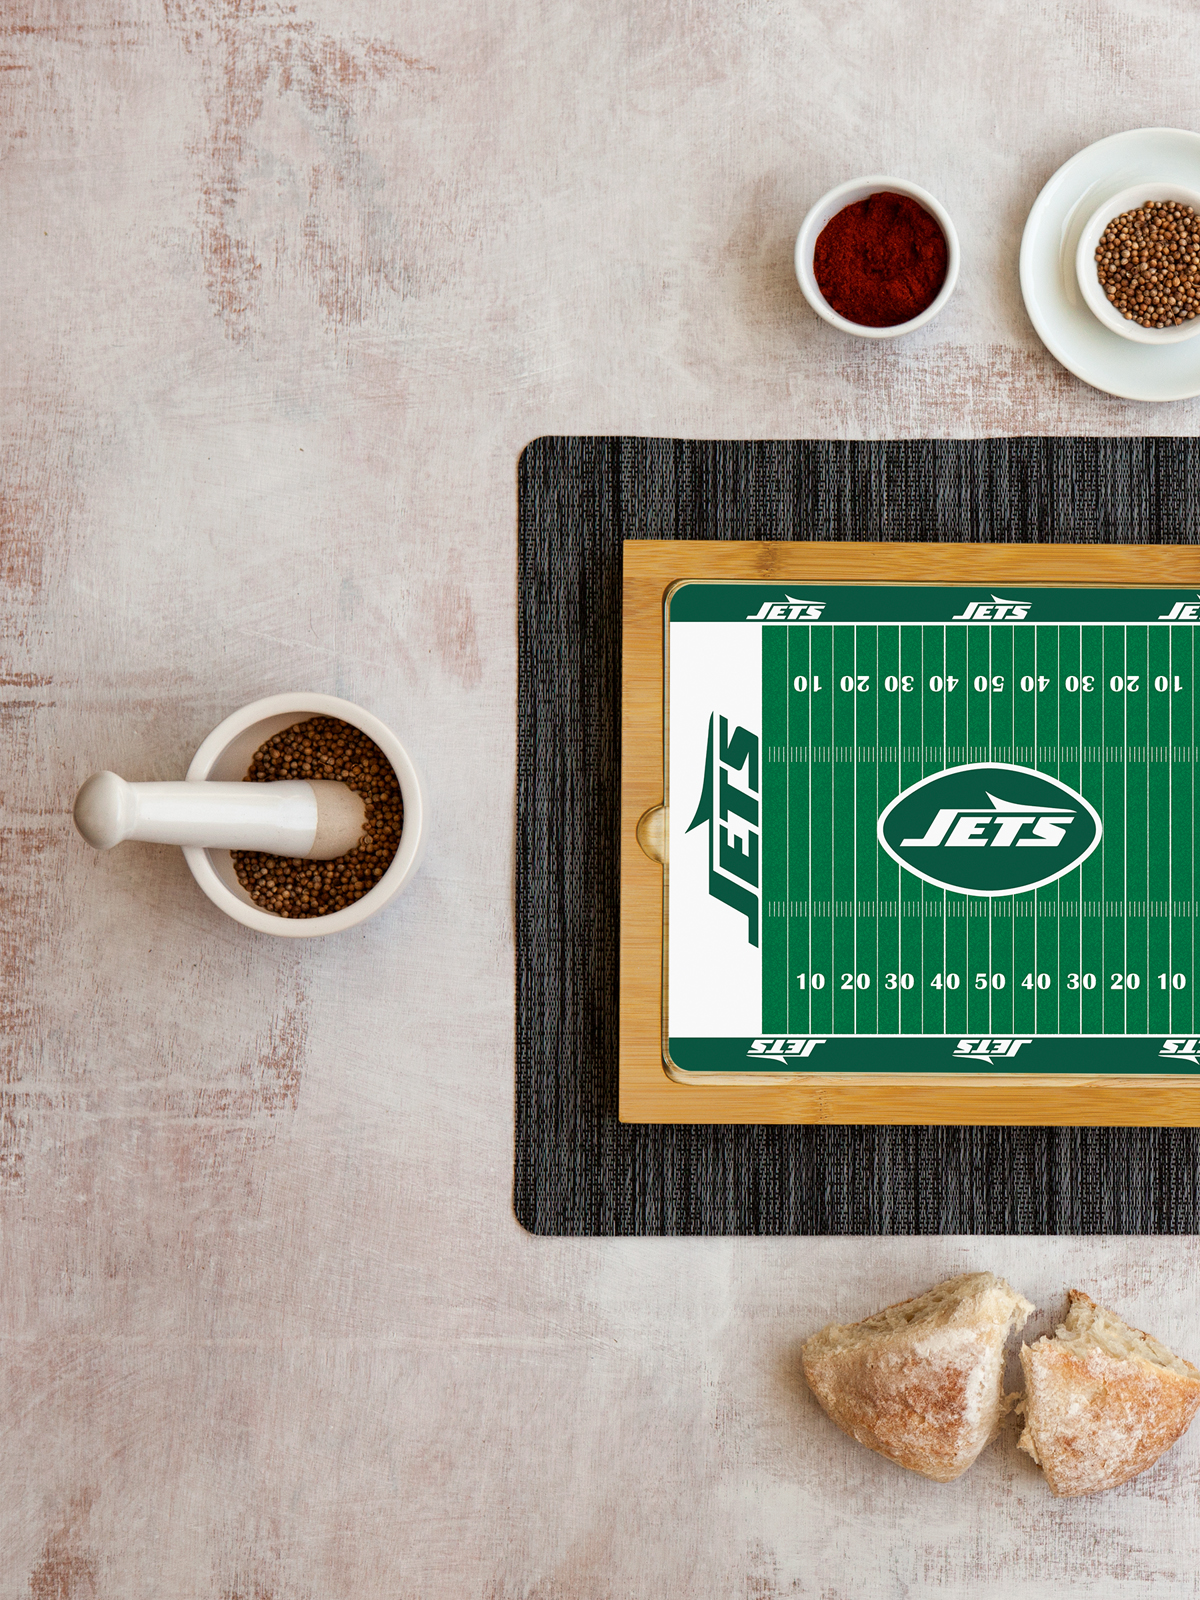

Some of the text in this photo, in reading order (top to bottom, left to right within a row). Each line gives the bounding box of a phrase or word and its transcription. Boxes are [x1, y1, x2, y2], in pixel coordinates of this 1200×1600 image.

[746, 599, 826, 620] JETS
[952, 599, 1032, 620] JETS
[793, 675, 1183, 692] 10 20 30 40 50 40 30 20 10
[706, 713, 759, 949] JETS
[899, 805, 1077, 847] JETS
[796, 973, 1187, 990] 10 20 30 40 50 40 30 20 10
[747, 1039, 827, 1058] JETS
[952, 1039, 1033, 1058] JETS
